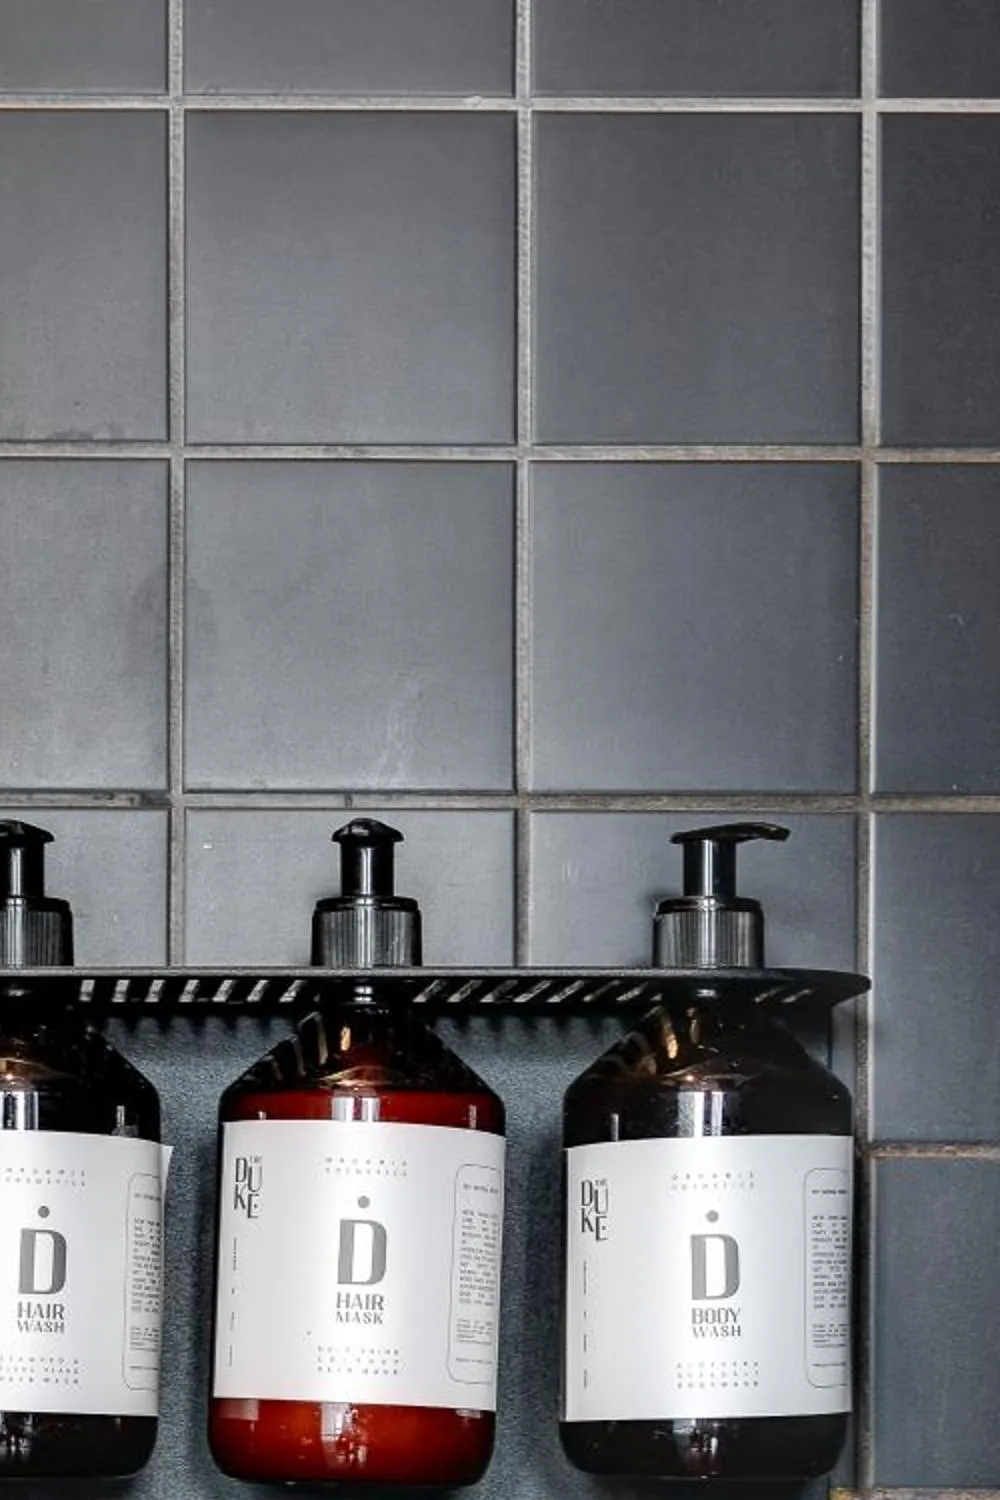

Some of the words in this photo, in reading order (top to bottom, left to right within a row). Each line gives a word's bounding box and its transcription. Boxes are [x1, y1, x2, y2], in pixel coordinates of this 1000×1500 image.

[336, 1291, 385, 1310] HAIR
[18, 1301, 65, 1320] HAIR
[336, 1310, 384, 1325] MASK
[691, 1307, 741, 1324] BODY
[17, 1319, 65, 1334] WASH
[692, 1325, 741, 1338] WASH
